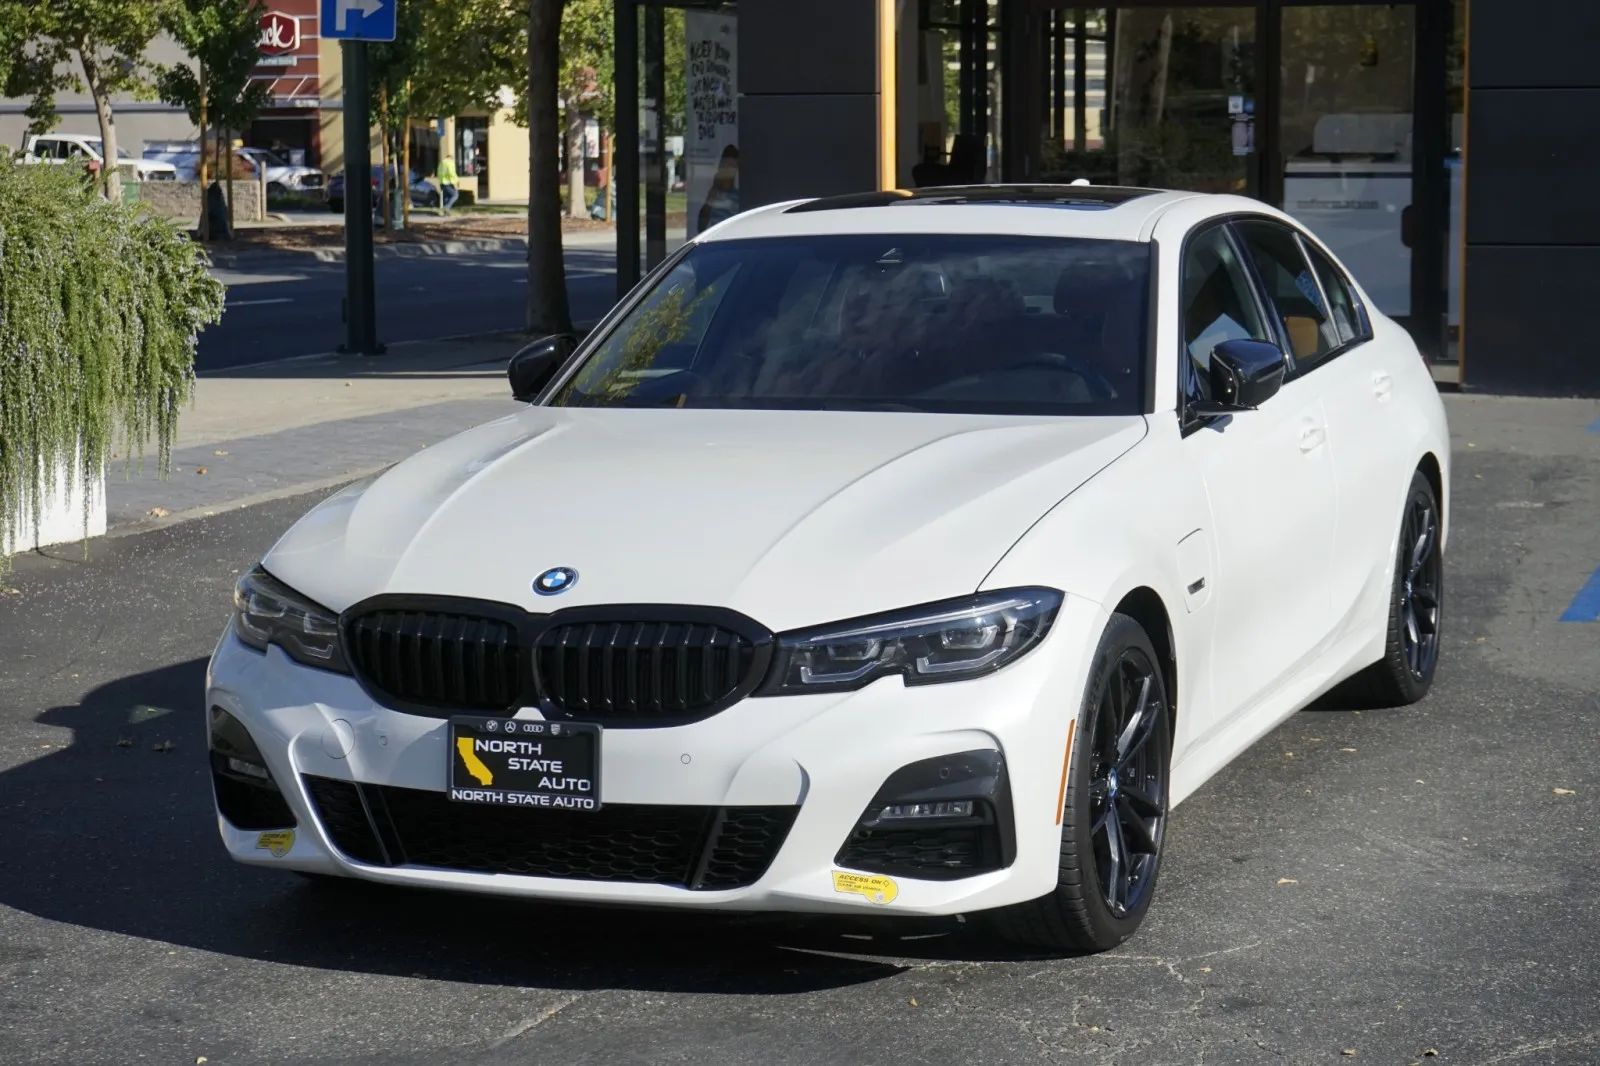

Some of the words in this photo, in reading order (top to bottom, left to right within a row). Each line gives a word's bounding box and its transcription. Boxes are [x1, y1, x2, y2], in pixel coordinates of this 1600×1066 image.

[475, 739, 542, 755] NORTH
[508, 757, 562, 773] STATE
[538, 776, 590, 791] AUTO
[452, 790, 503, 803] NORTH
[507, 793, 549, 806] STATE
[553, 796, 594, 809] AUTO
[839, 875, 869, 883] ACCESS
